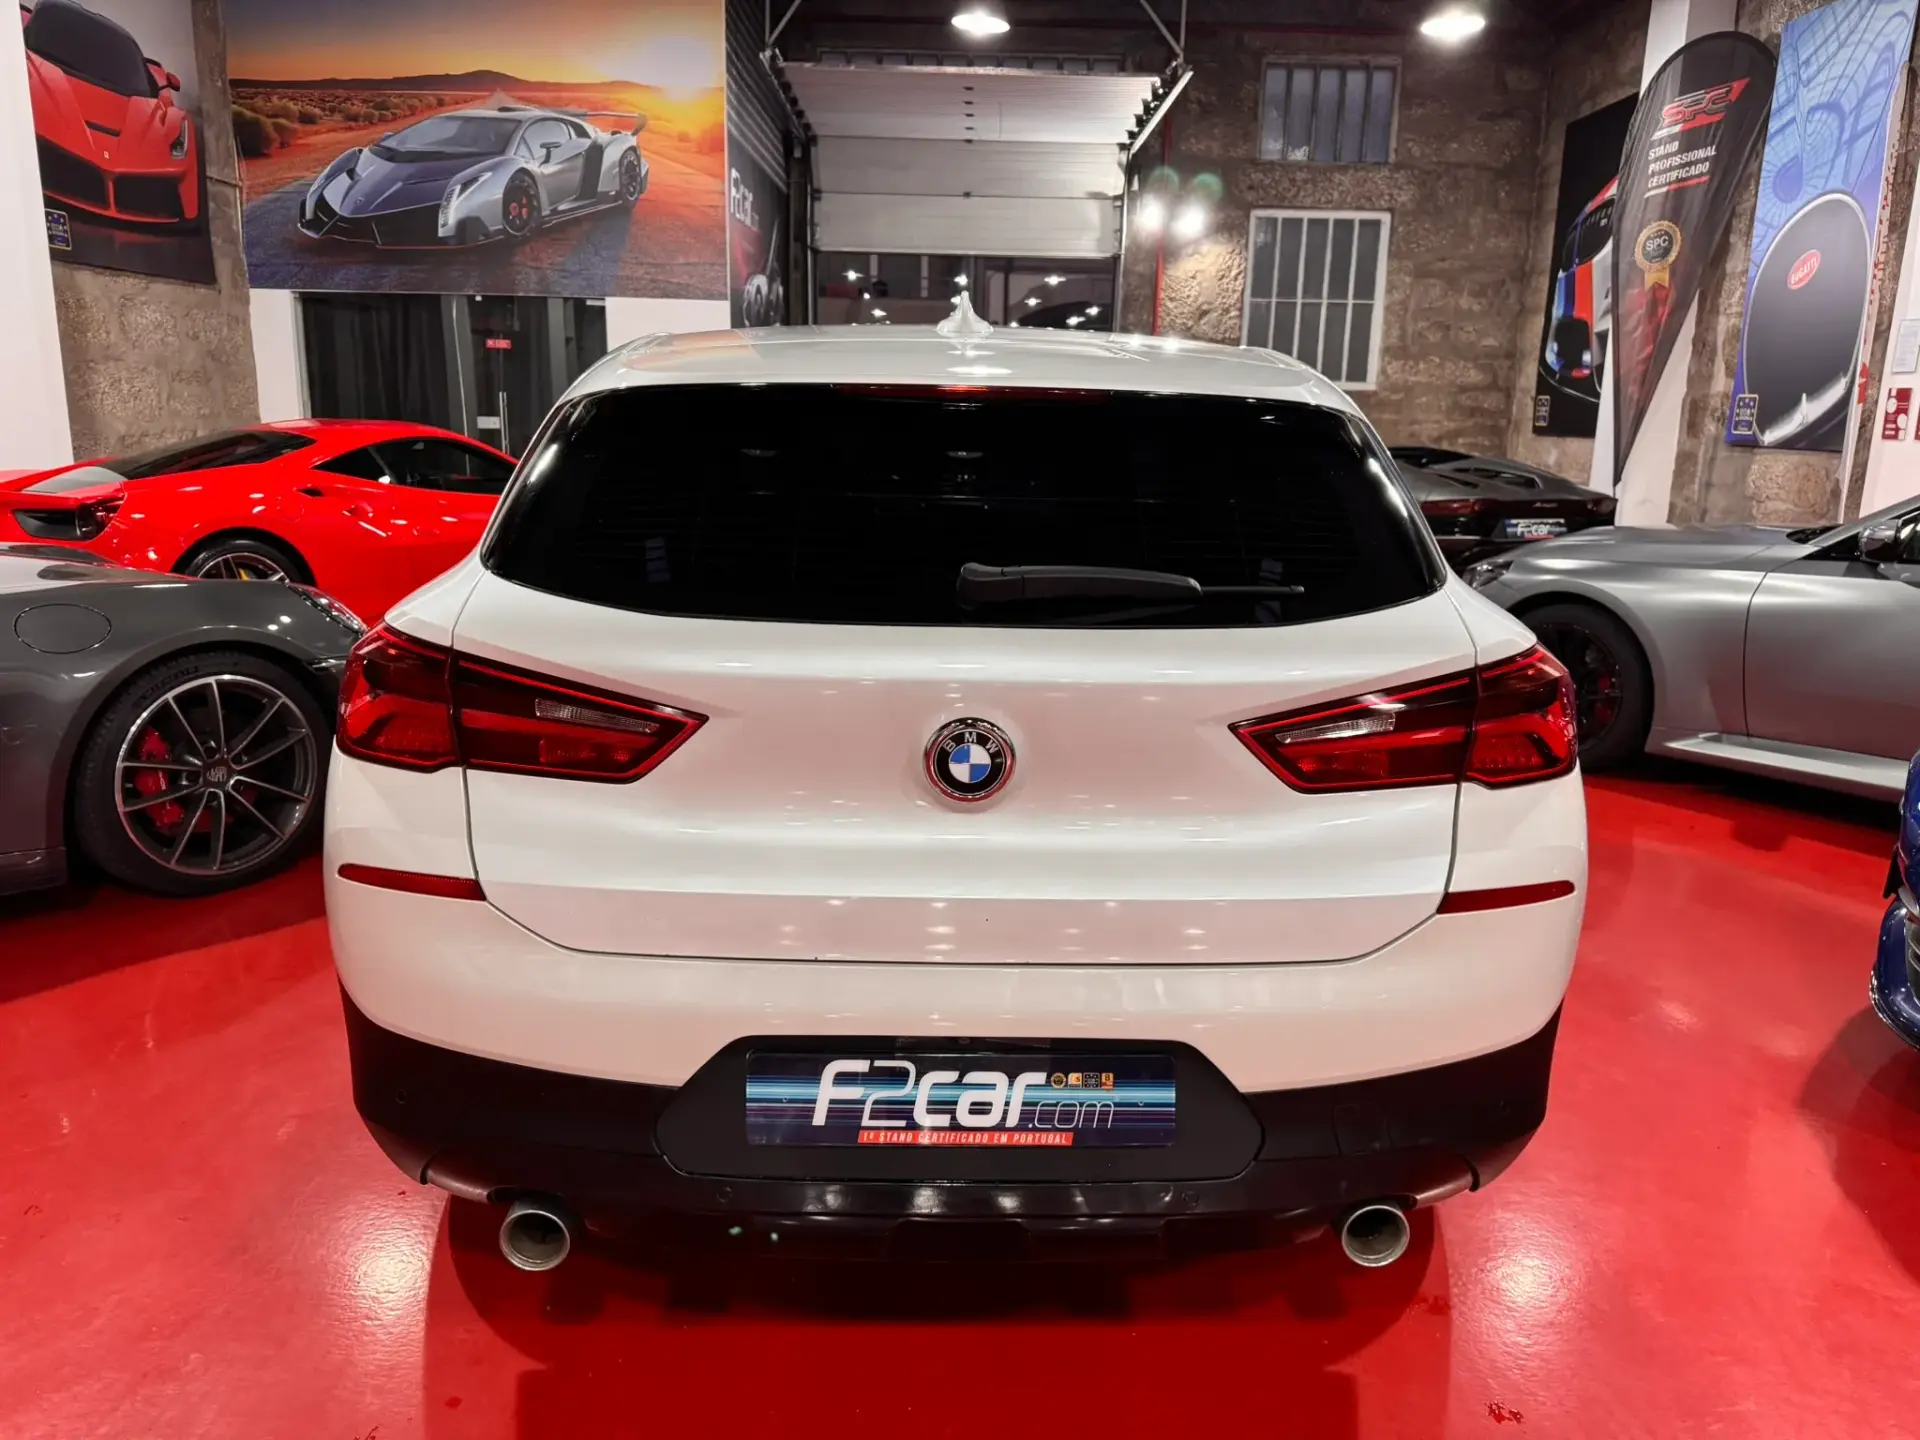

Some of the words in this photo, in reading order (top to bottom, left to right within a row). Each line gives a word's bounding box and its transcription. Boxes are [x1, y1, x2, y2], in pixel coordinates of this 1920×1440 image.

[1648, 141, 1679, 160] STAND
[1648, 145, 1717, 174] PROFISSIONAL
[1648, 162, 1710, 188] CERTIFICADO
[1646, 236, 1669, 250] SPC
[942, 731, 999, 754] BMW
[879, 1131, 913, 1143] STAND
[918, 1131, 989, 1145] CERTIFICADO
[993, 1133, 1008, 1144] EM
[1013, 1133, 1066, 1145] PORTUGAL
